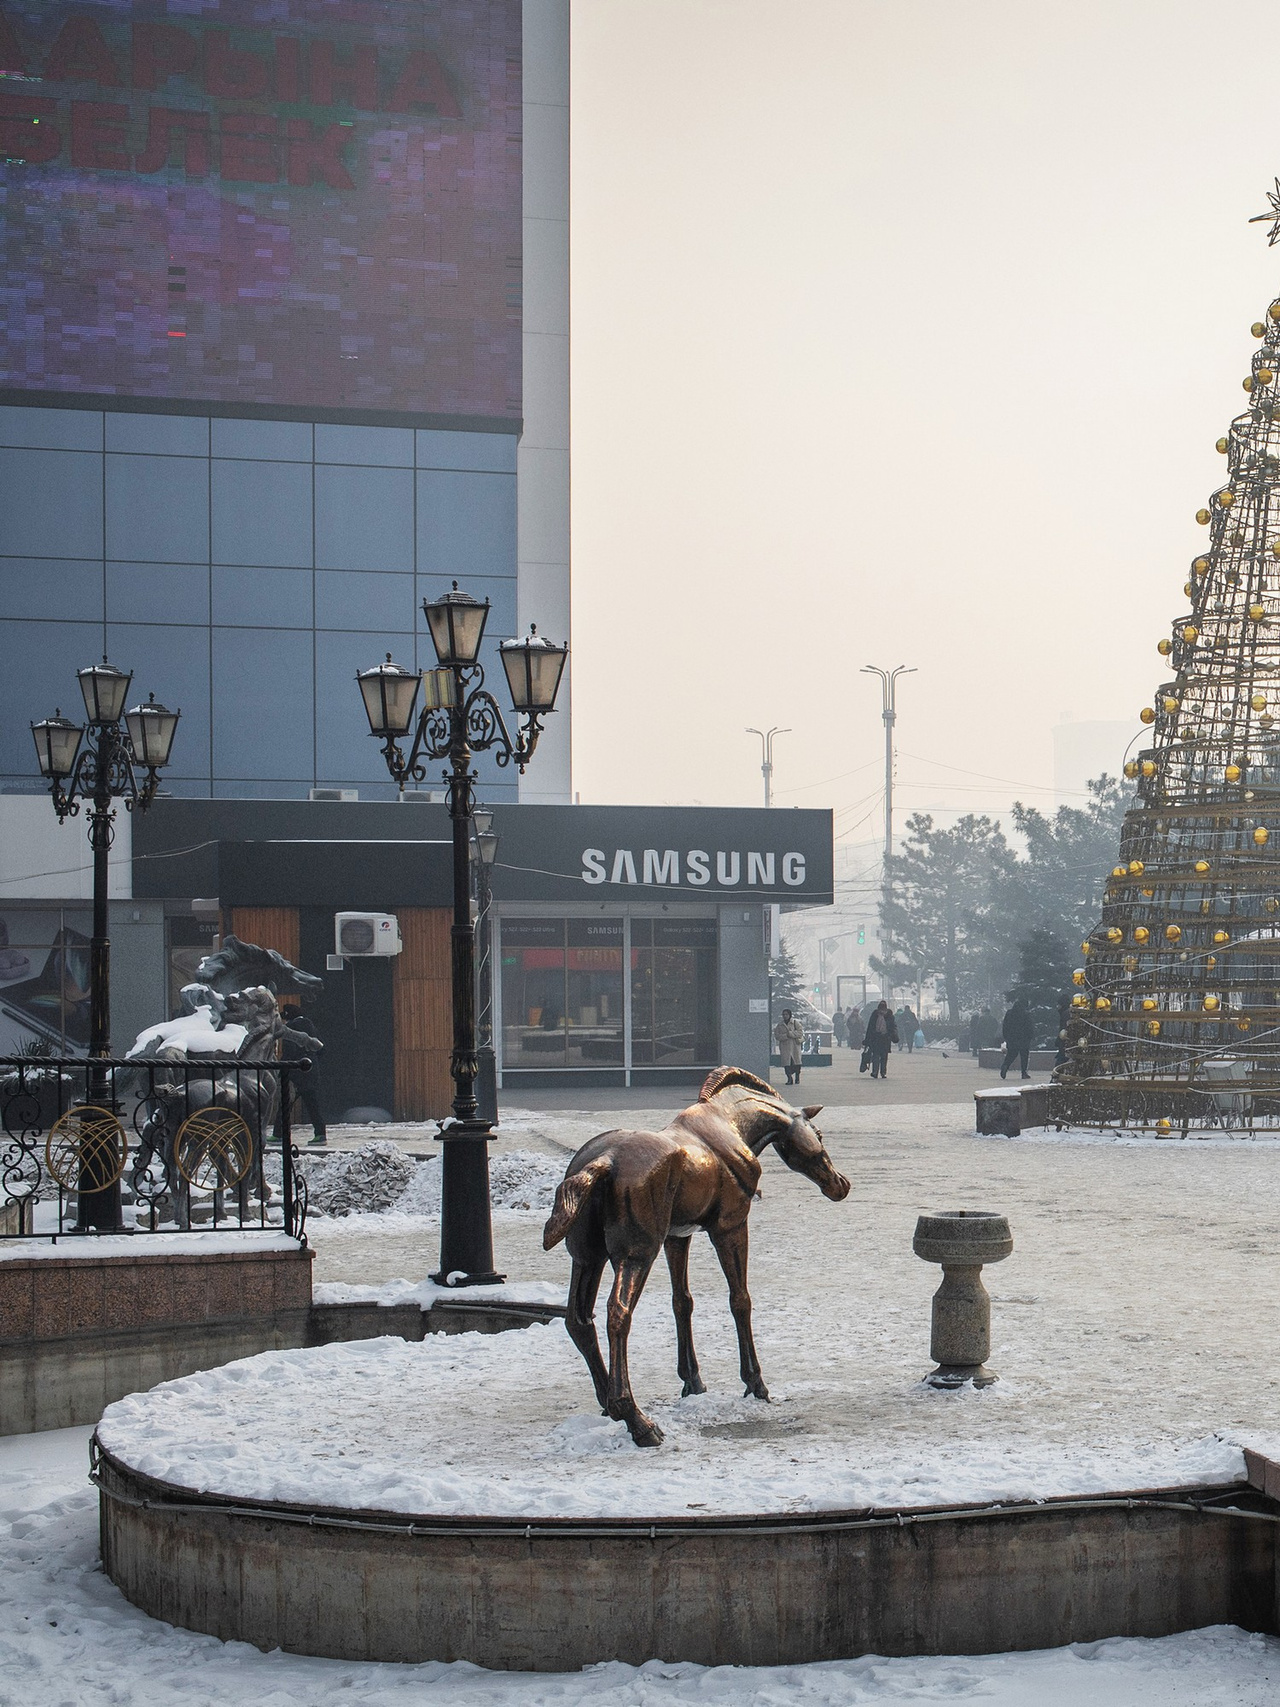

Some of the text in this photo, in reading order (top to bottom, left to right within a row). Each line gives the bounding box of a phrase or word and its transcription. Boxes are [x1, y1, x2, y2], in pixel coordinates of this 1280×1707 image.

[581, 848, 807, 887] SAMSUNG
[199, 924, 220, 933] SAM
[587, 926, 624, 935] SAMSUN
